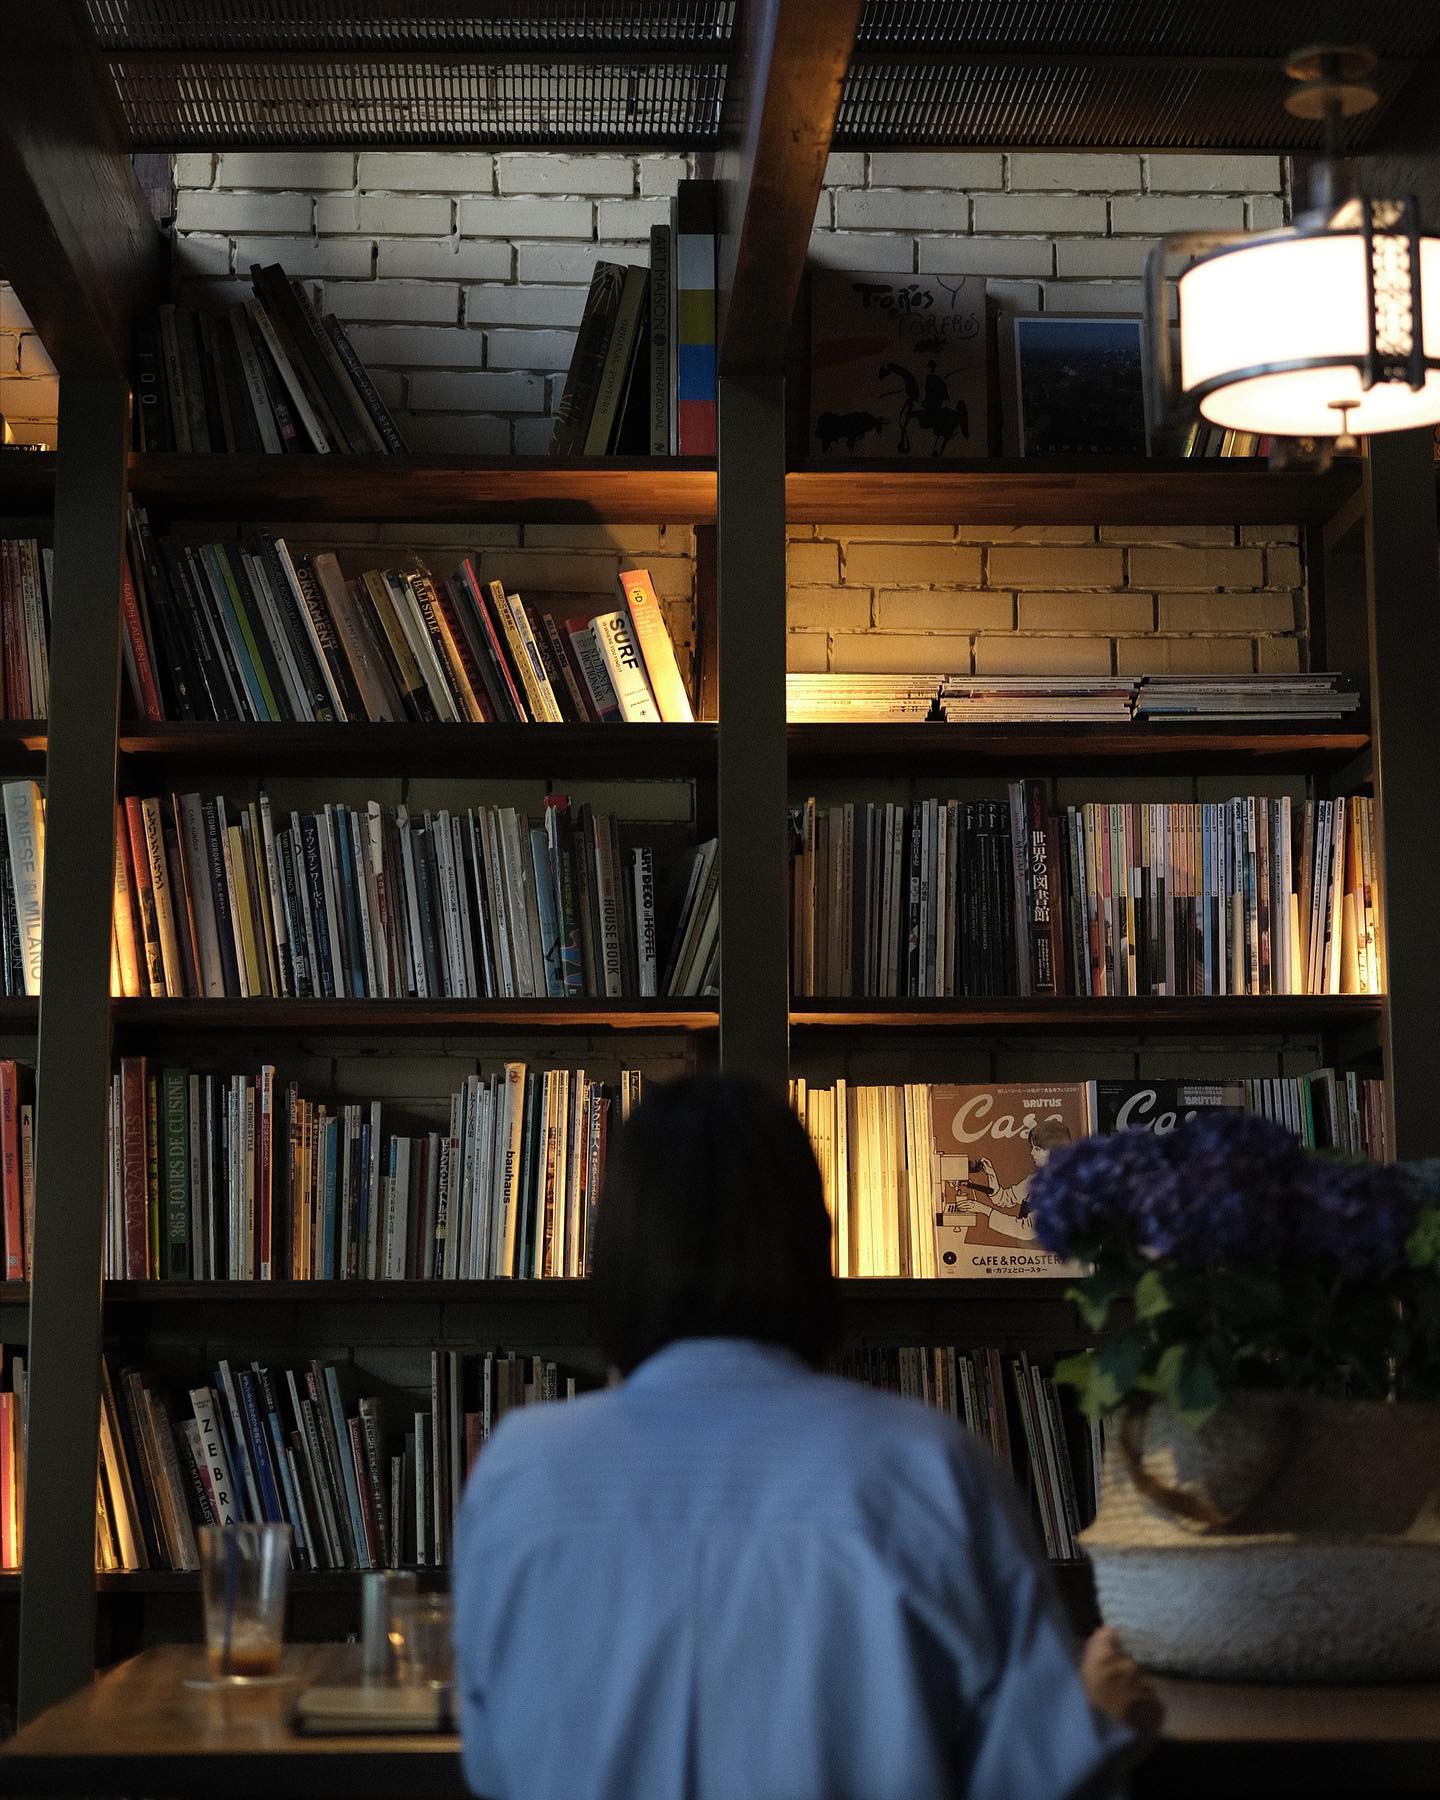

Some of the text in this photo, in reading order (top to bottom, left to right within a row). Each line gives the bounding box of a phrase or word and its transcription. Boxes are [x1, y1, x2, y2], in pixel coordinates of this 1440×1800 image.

[654, 236, 666, 430] ART MAISON INTERNATIONAL
[600, 320, 629, 416] ORIGINAL POSTERS
[122, 584, 145, 663] RALPH LAUREN
[297, 568, 332, 651] ORNAMENT
[412, 580, 440, 634] BALI STYLE
[609, 620, 639, 670] SURF
[580, 651, 605, 703] DICTIONARY
[205, 802, 217, 836] TSUTOMU
[146, 808, 164, 890] レタリングデザイン
[210, 838, 222, 878] KUROKAWA
[304, 828, 323, 909] マウンテンワールド
[641, 848, 653, 873] ART
[13, 795, 35, 872] DANESE
[25, 901, 41, 980] MILANO
[642, 874, 653, 909] DECO
[1032, 830, 1050, 923] 世界の図書館
[604, 899, 616, 938] HOUSE
[644, 918, 655, 961] HOTEL
[295, 955, 306, 978] WEST
[606, 942, 619, 974] BOOK
[1023, 1099, 1062, 1108] BRUTUS
[1185, 1096, 1222, 1105] BRUTUS
[2, 1088, 14, 1174] Tropical Style
[168, 1076, 186, 1237] 365 JOURS DE CUISINE
[126, 1115, 144, 1231] VERSAILLES
[503, 1151, 515, 1204] bauhaus
[972, 1254, 1060, 1266] CAFE & ROASTER
[202, 1419, 234, 1525] ZEBRA
